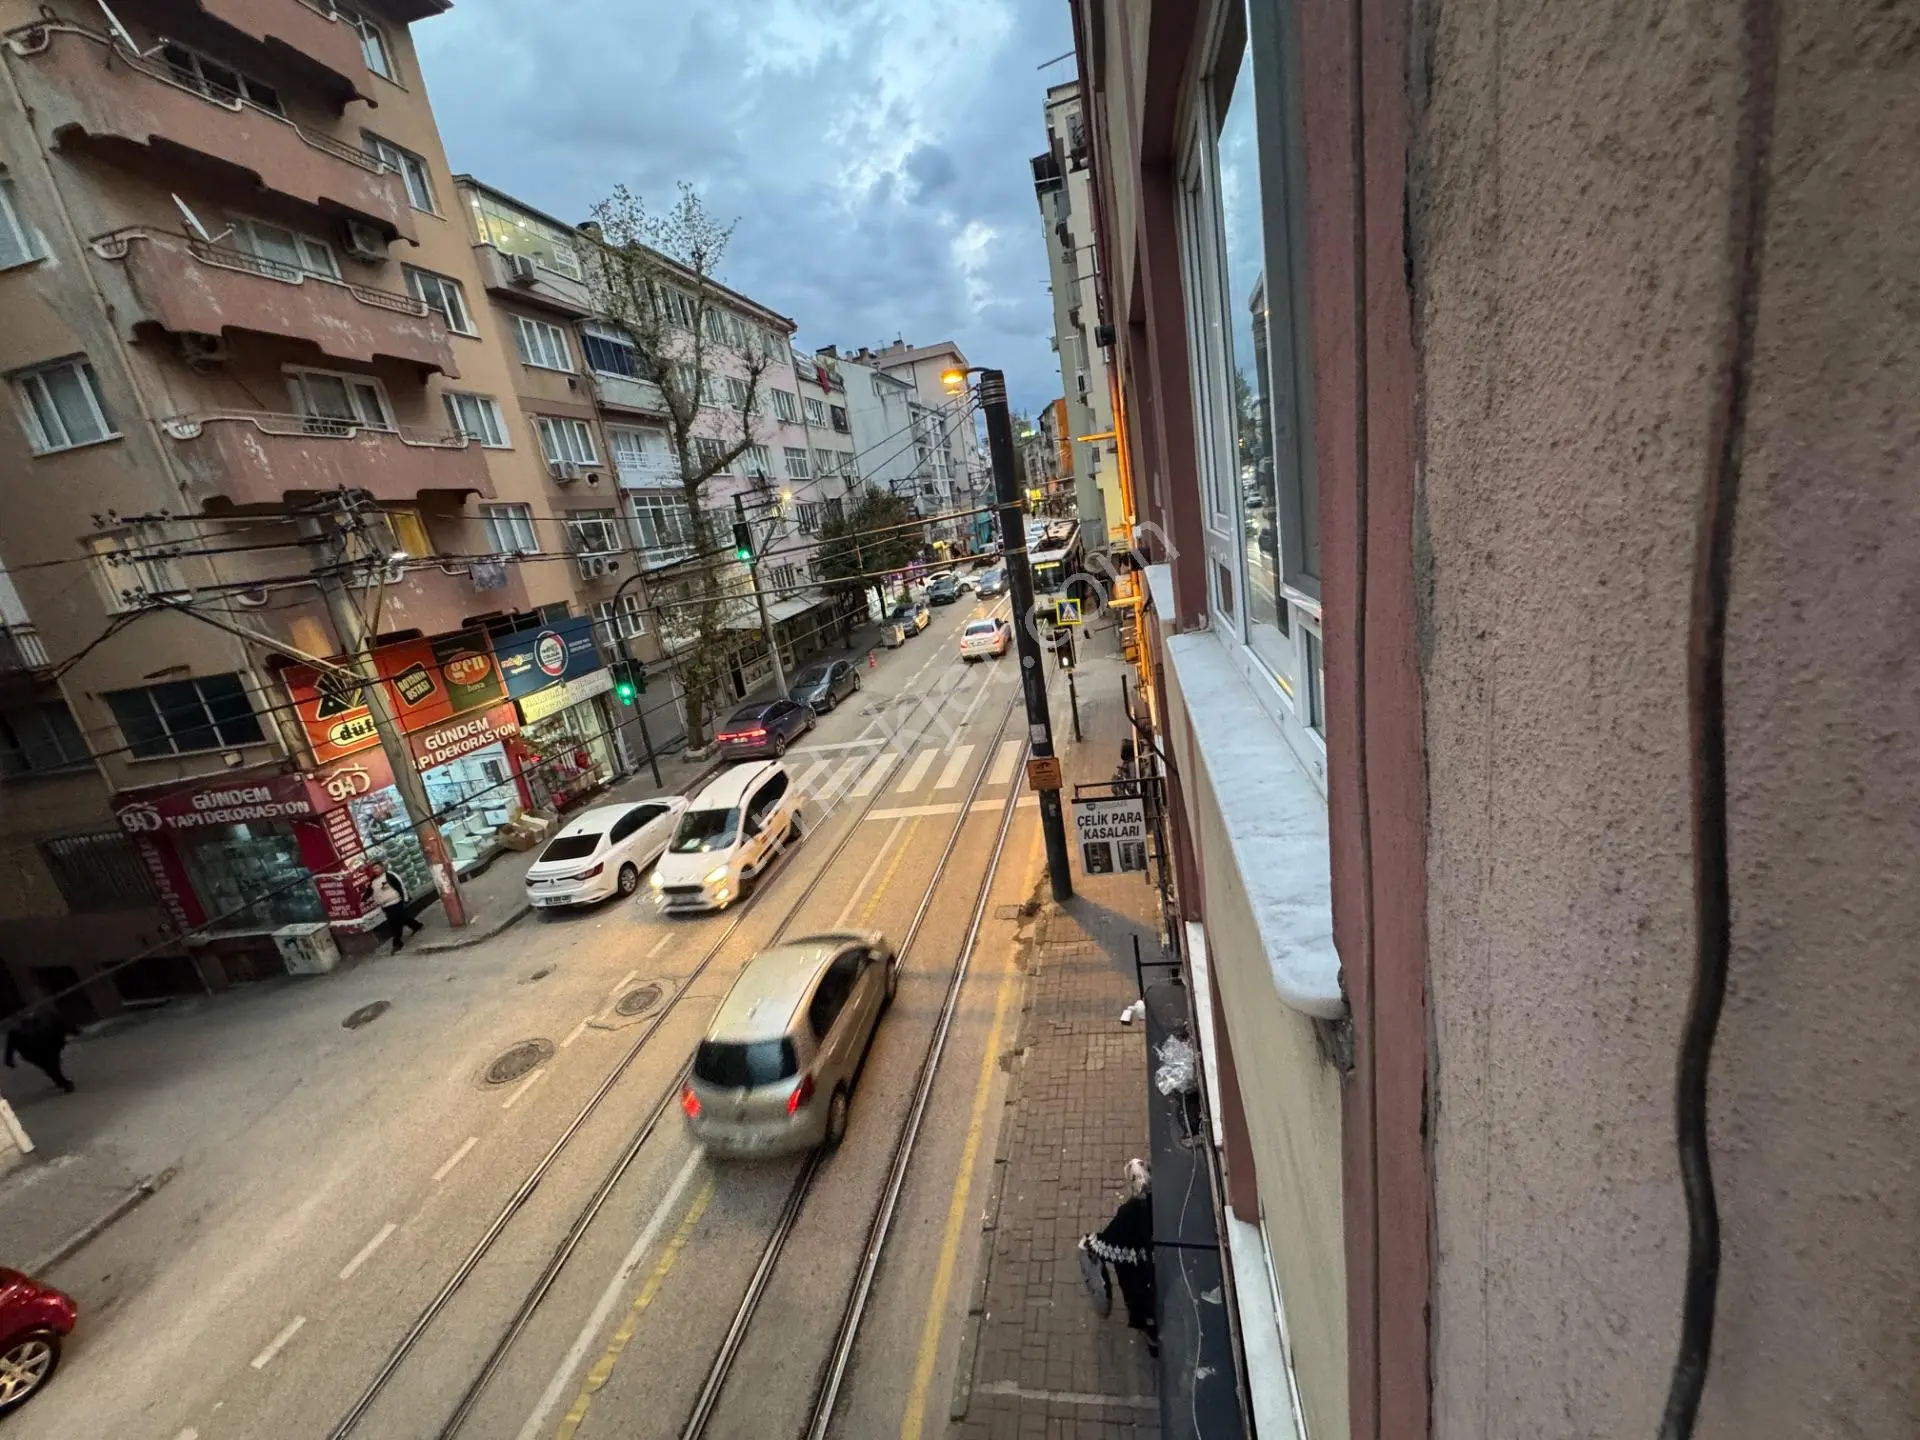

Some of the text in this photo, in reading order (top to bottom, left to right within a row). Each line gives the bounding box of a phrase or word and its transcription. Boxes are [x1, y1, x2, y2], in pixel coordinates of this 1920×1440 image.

[340, 718, 375, 741] düf
[425, 717, 490, 750] GÜNDEM
[436, 722, 516, 761] DEKORASYON
[192, 786, 272, 810] GÜNDEM
[204, 801, 310, 825] DEKORASYON
[1077, 811, 1142, 830] ÇELİK PARA
[1083, 825, 1140, 840] KASALARI
